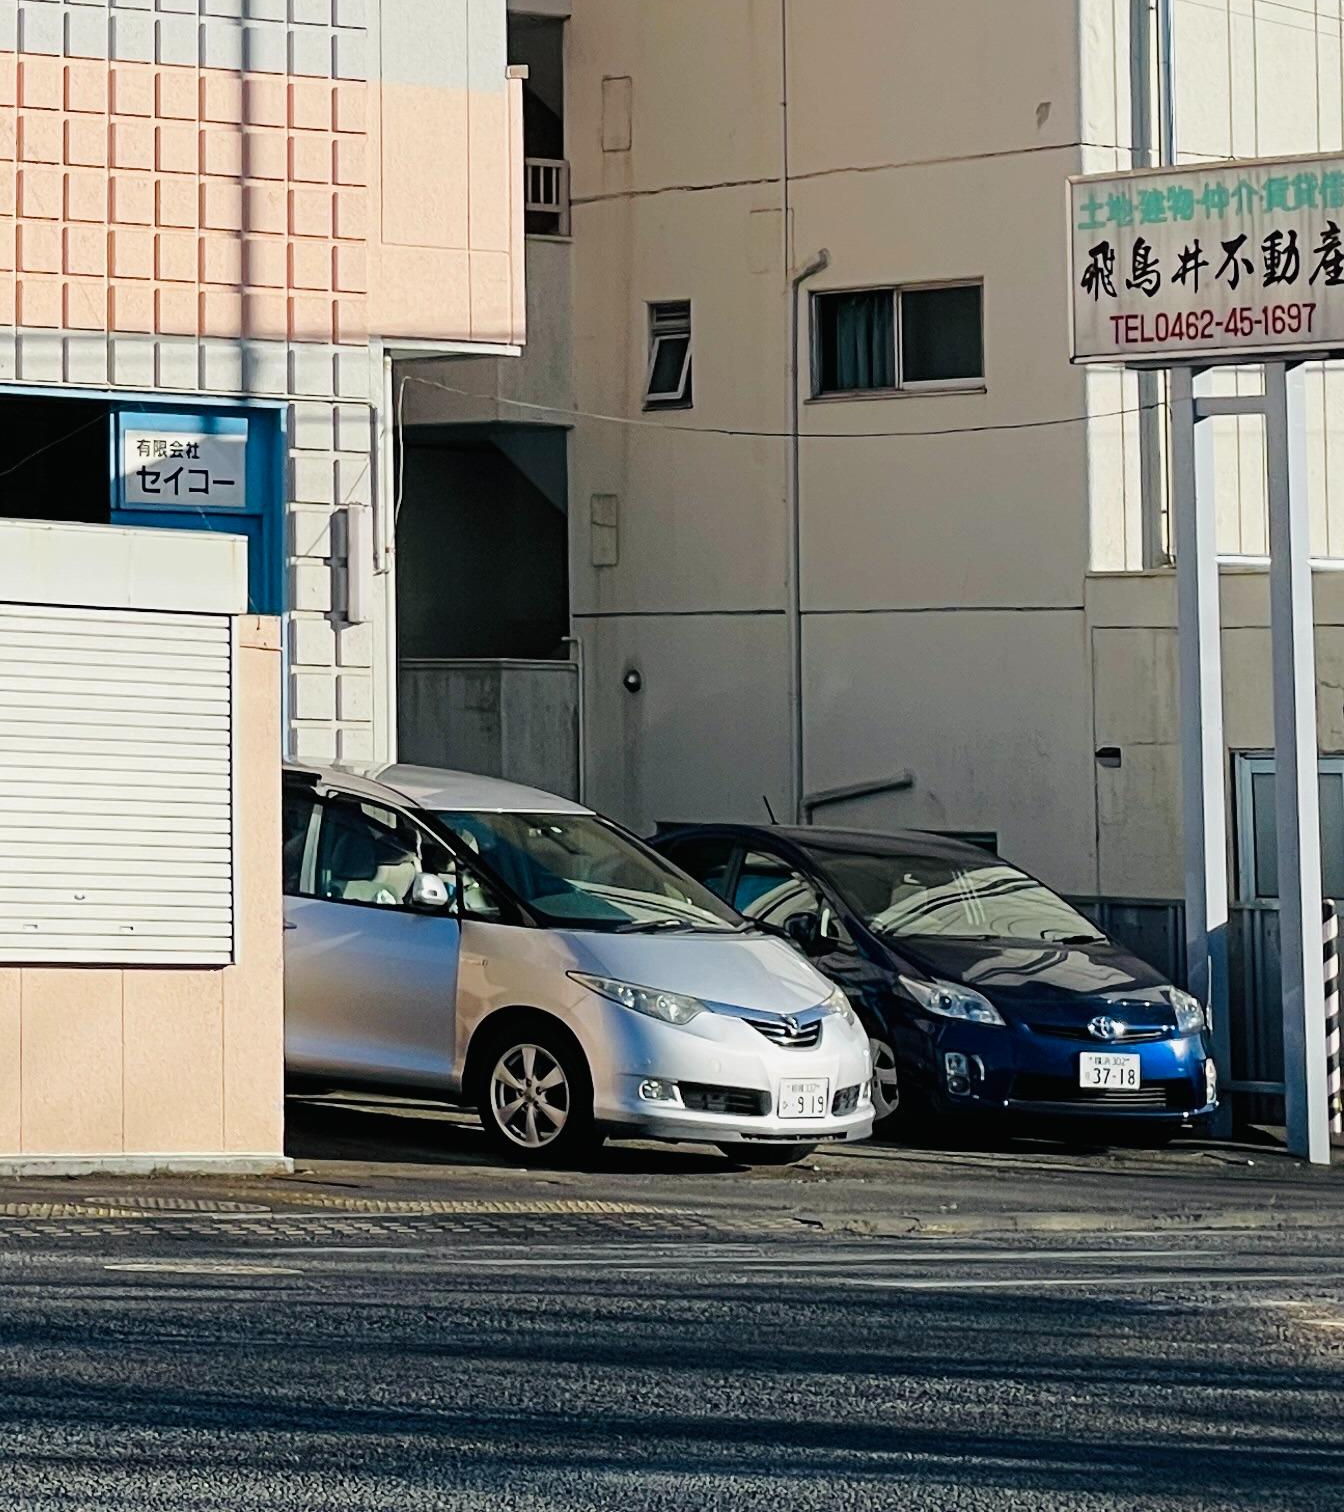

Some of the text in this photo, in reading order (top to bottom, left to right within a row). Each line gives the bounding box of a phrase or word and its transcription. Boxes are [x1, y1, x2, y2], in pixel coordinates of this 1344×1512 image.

[1080, 219, 1344, 302] 飛鳥井不動産
[1110, 302, 1317, 345] TEL0462-45-1697
[136, 438, 201, 460] 有限会社
[135, 465, 235, 496] セイコー
[1092, 1067, 1136, 1086] 37-18
